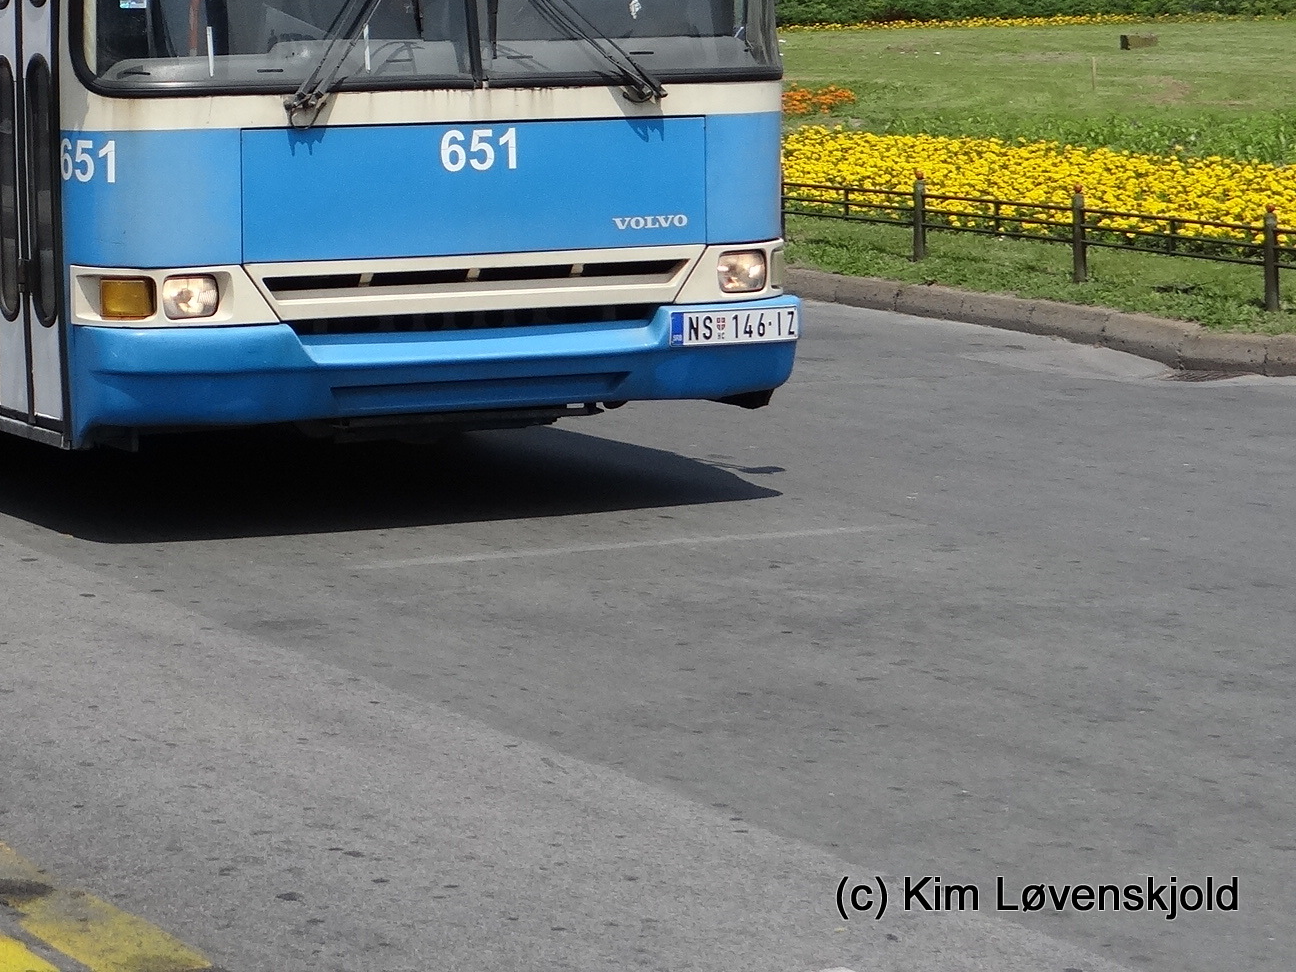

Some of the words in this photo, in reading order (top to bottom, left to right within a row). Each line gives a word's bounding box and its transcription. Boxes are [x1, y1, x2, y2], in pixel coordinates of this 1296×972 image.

[59, 139, 117, 183] 651
[441, 128, 518, 172] 651
[612, 212, 688, 231] VOLVO
[688, 316, 713, 341] NS
